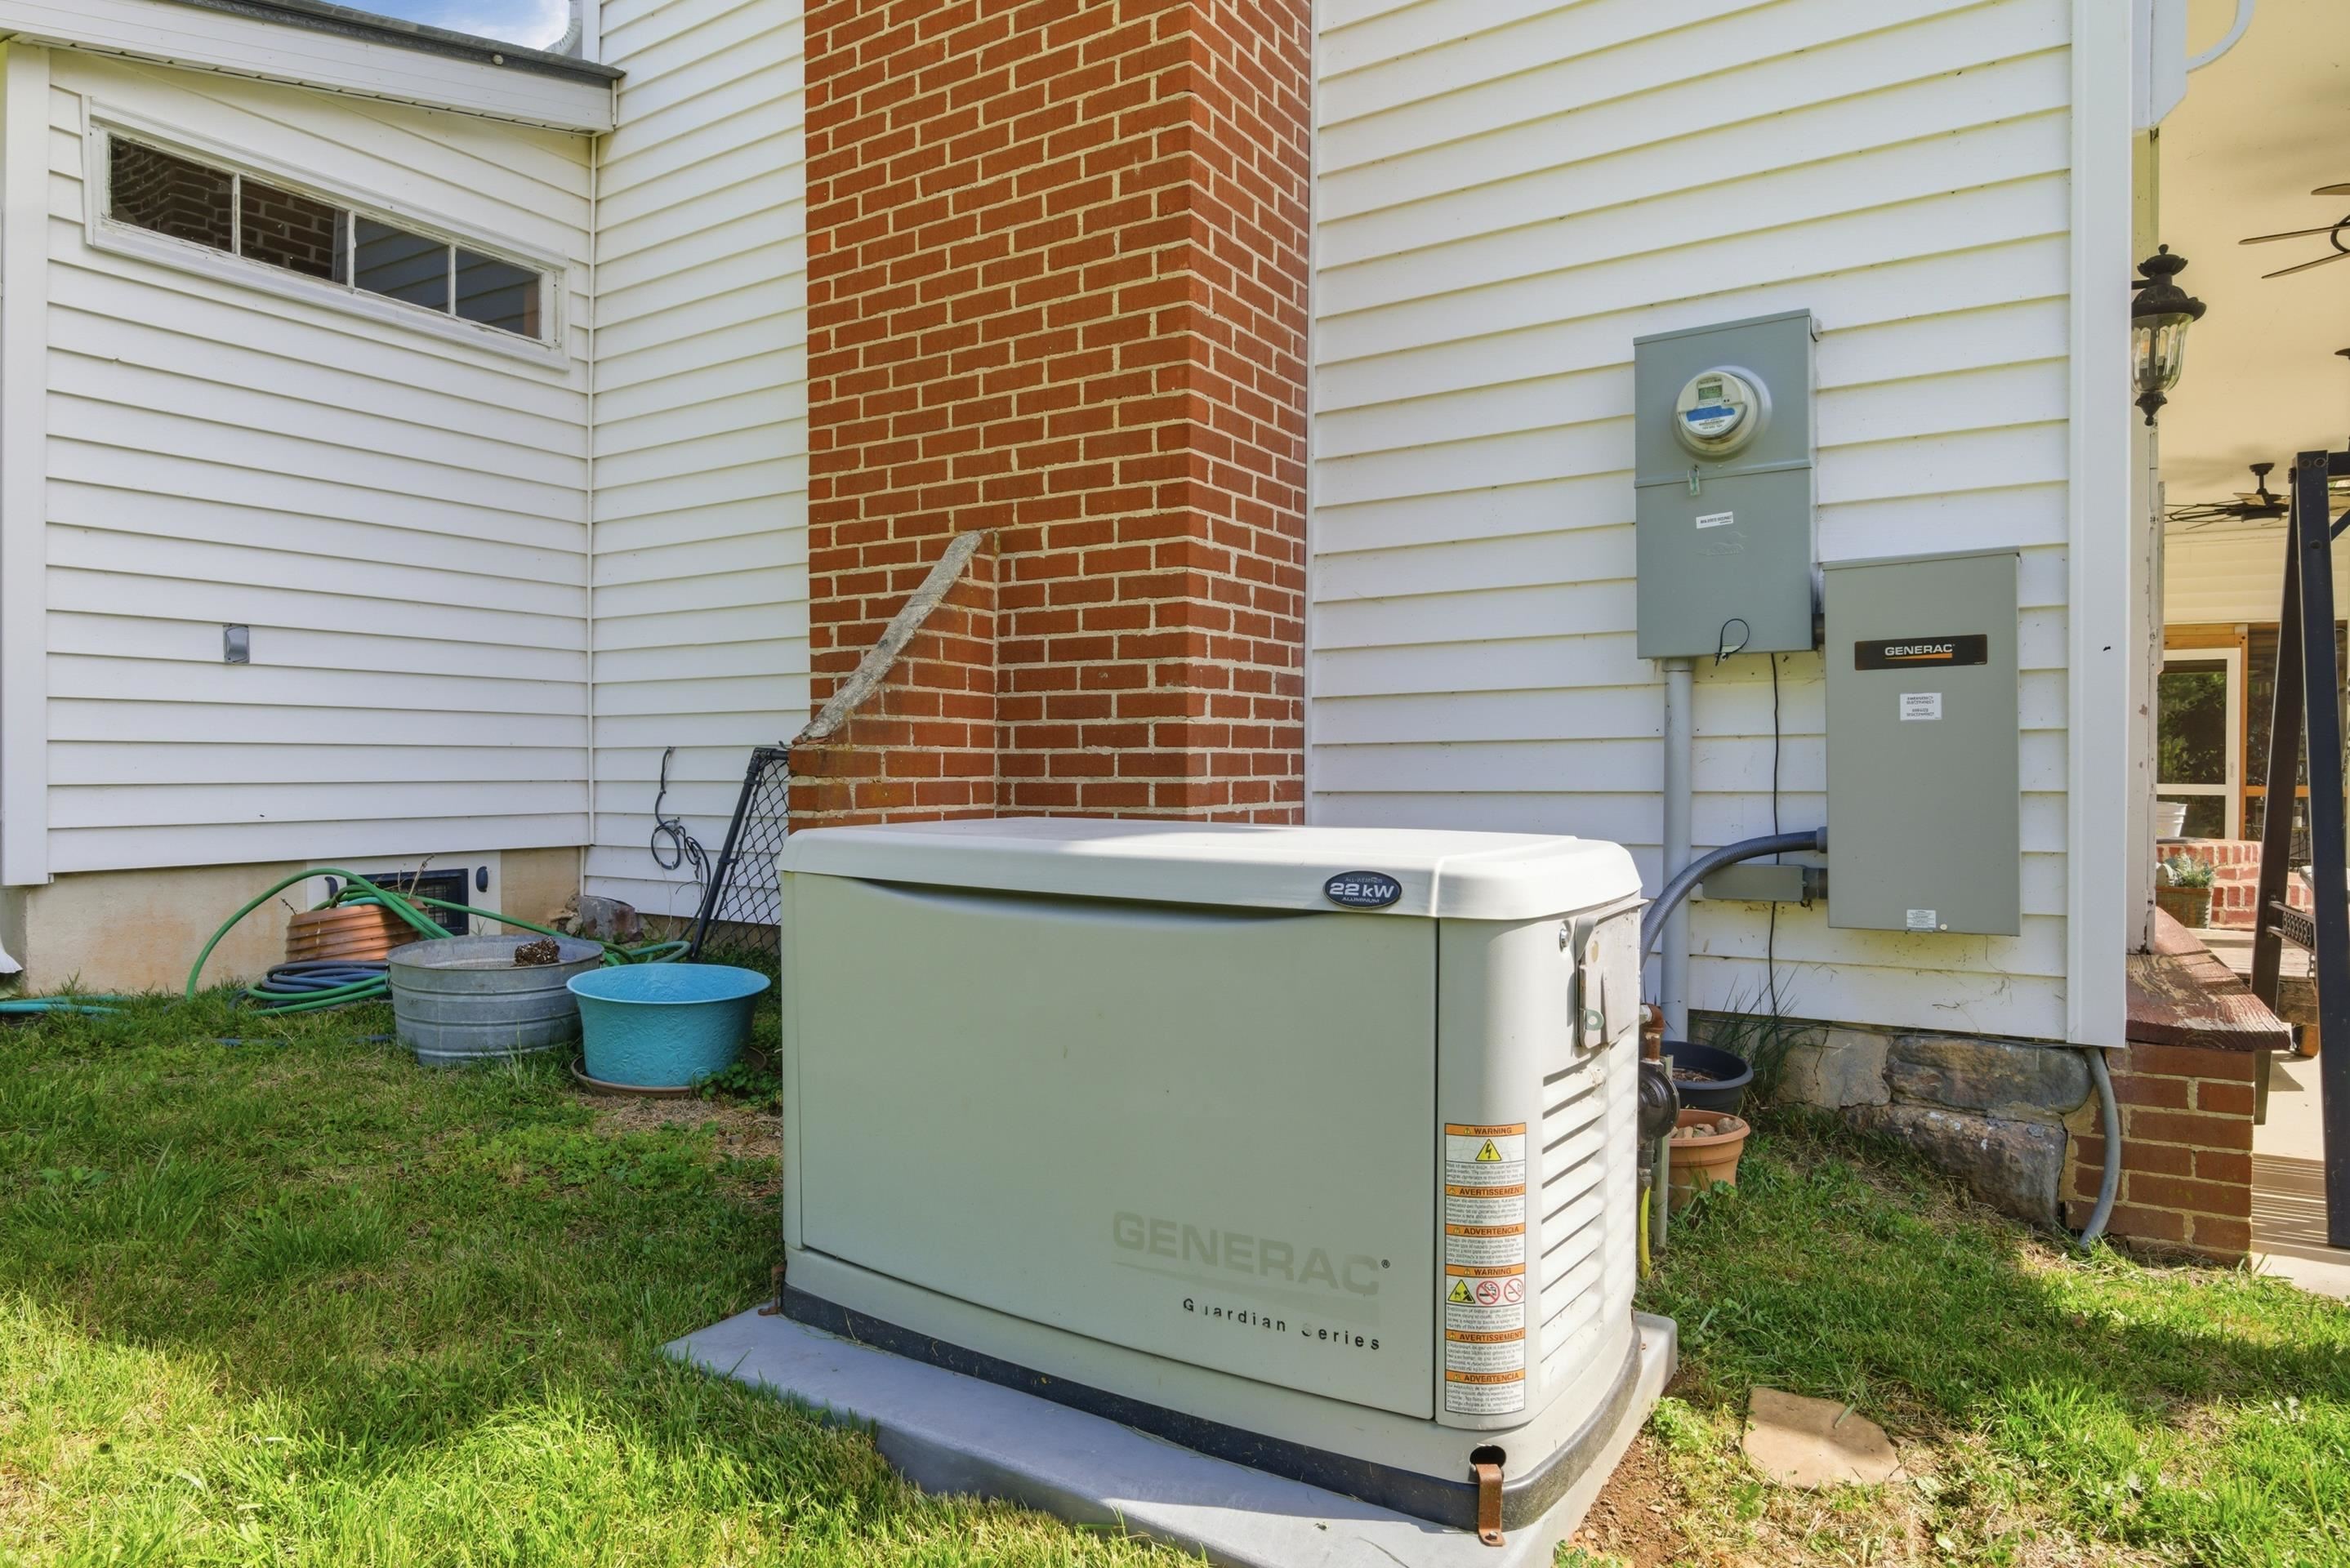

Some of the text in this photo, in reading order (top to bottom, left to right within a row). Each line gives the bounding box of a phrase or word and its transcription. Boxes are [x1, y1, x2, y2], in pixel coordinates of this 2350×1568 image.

[1884, 644, 1953, 656] GENERAC
[1329, 882, 1394, 898] 22 kW
[1474, 1127, 1513, 1135] WARNING
[1459, 1187, 1523, 1196] AVERTISSEMENT
[1464, 1226, 1519, 1235] ADVERTENCIA
[1113, 1211, 1380, 1296] GENERAC
[1474, 1267, 1512, 1276] WARNING
[1459, 1331, 1523, 1342] AVERTISSEMENT
[1464, 1372, 1520, 1382] ADVERTENCIA
